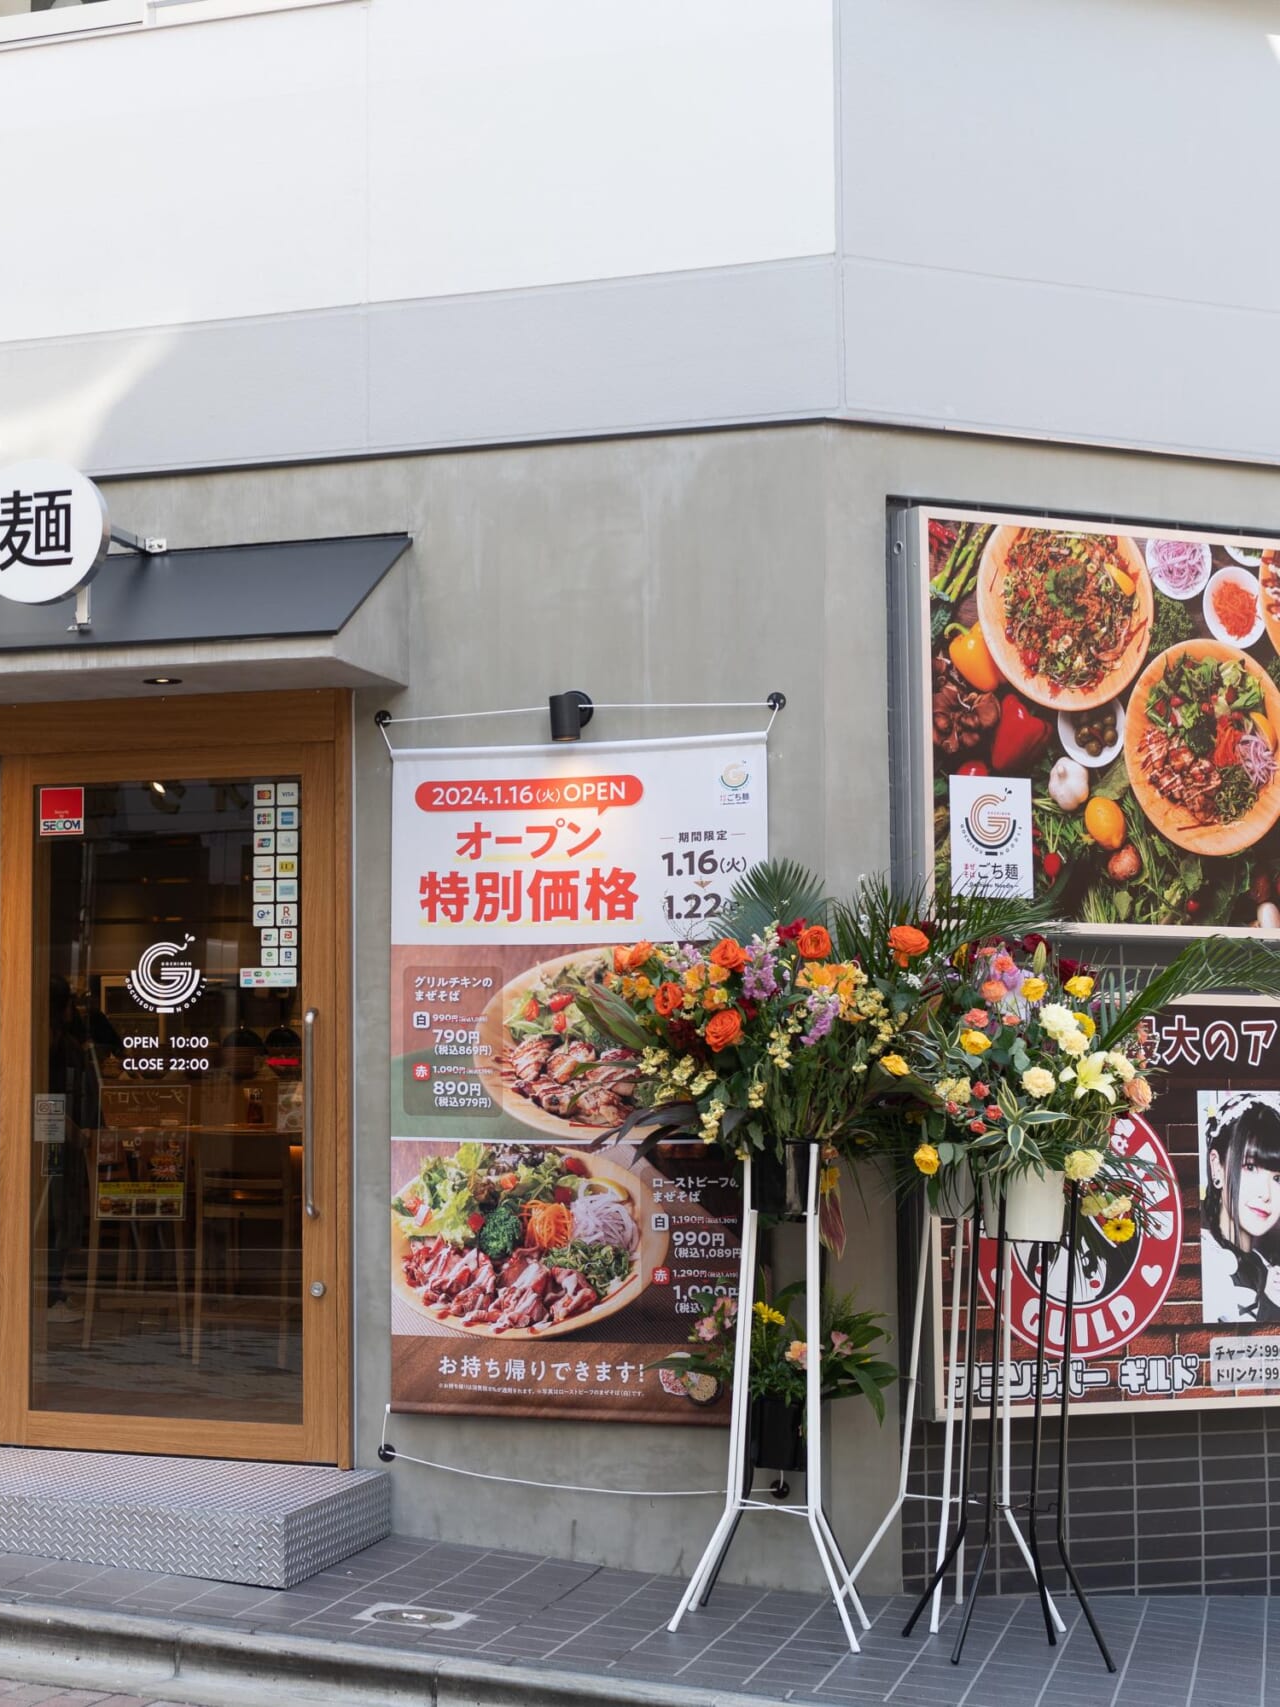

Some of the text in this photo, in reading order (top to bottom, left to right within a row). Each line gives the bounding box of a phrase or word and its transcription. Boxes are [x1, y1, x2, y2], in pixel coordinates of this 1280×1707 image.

[43, 820, 81, 831] SECOM
[455, 817, 602, 861] オープン
[678, 830, 728, 843] 期間限定
[978, 862, 1019, 880] ごち麺
[419, 867, 639, 923] 特別価格
[415, 976, 493, 988] グリルチキンの
[415, 990, 461, 1002] まぜそば
[416, 1014, 427, 1026] 白
[123, 1036, 209, 1049] OPEN 10:00
[432, 1029, 480, 1045] 790円
[434, 1045, 493, 1056] (税込869円)
[123, 1058, 209, 1071] CLOSE 22:00
[415, 1065, 428, 1078] 赤
[433, 1081, 481, 1097] 890円
[434, 1097, 492, 1108] (税込979円)
[652, 1191, 702, 1203] まぜそば
[654, 1216, 666, 1228] 白
[672, 1231, 725, 1246] 990円
[674, 1248, 742, 1260] (税込1,089円
[654, 1269, 668, 1282] 赤
[438, 1355, 645, 1383] お持ち帰りできます!
[1118, 1356, 1199, 1394] ギルド
